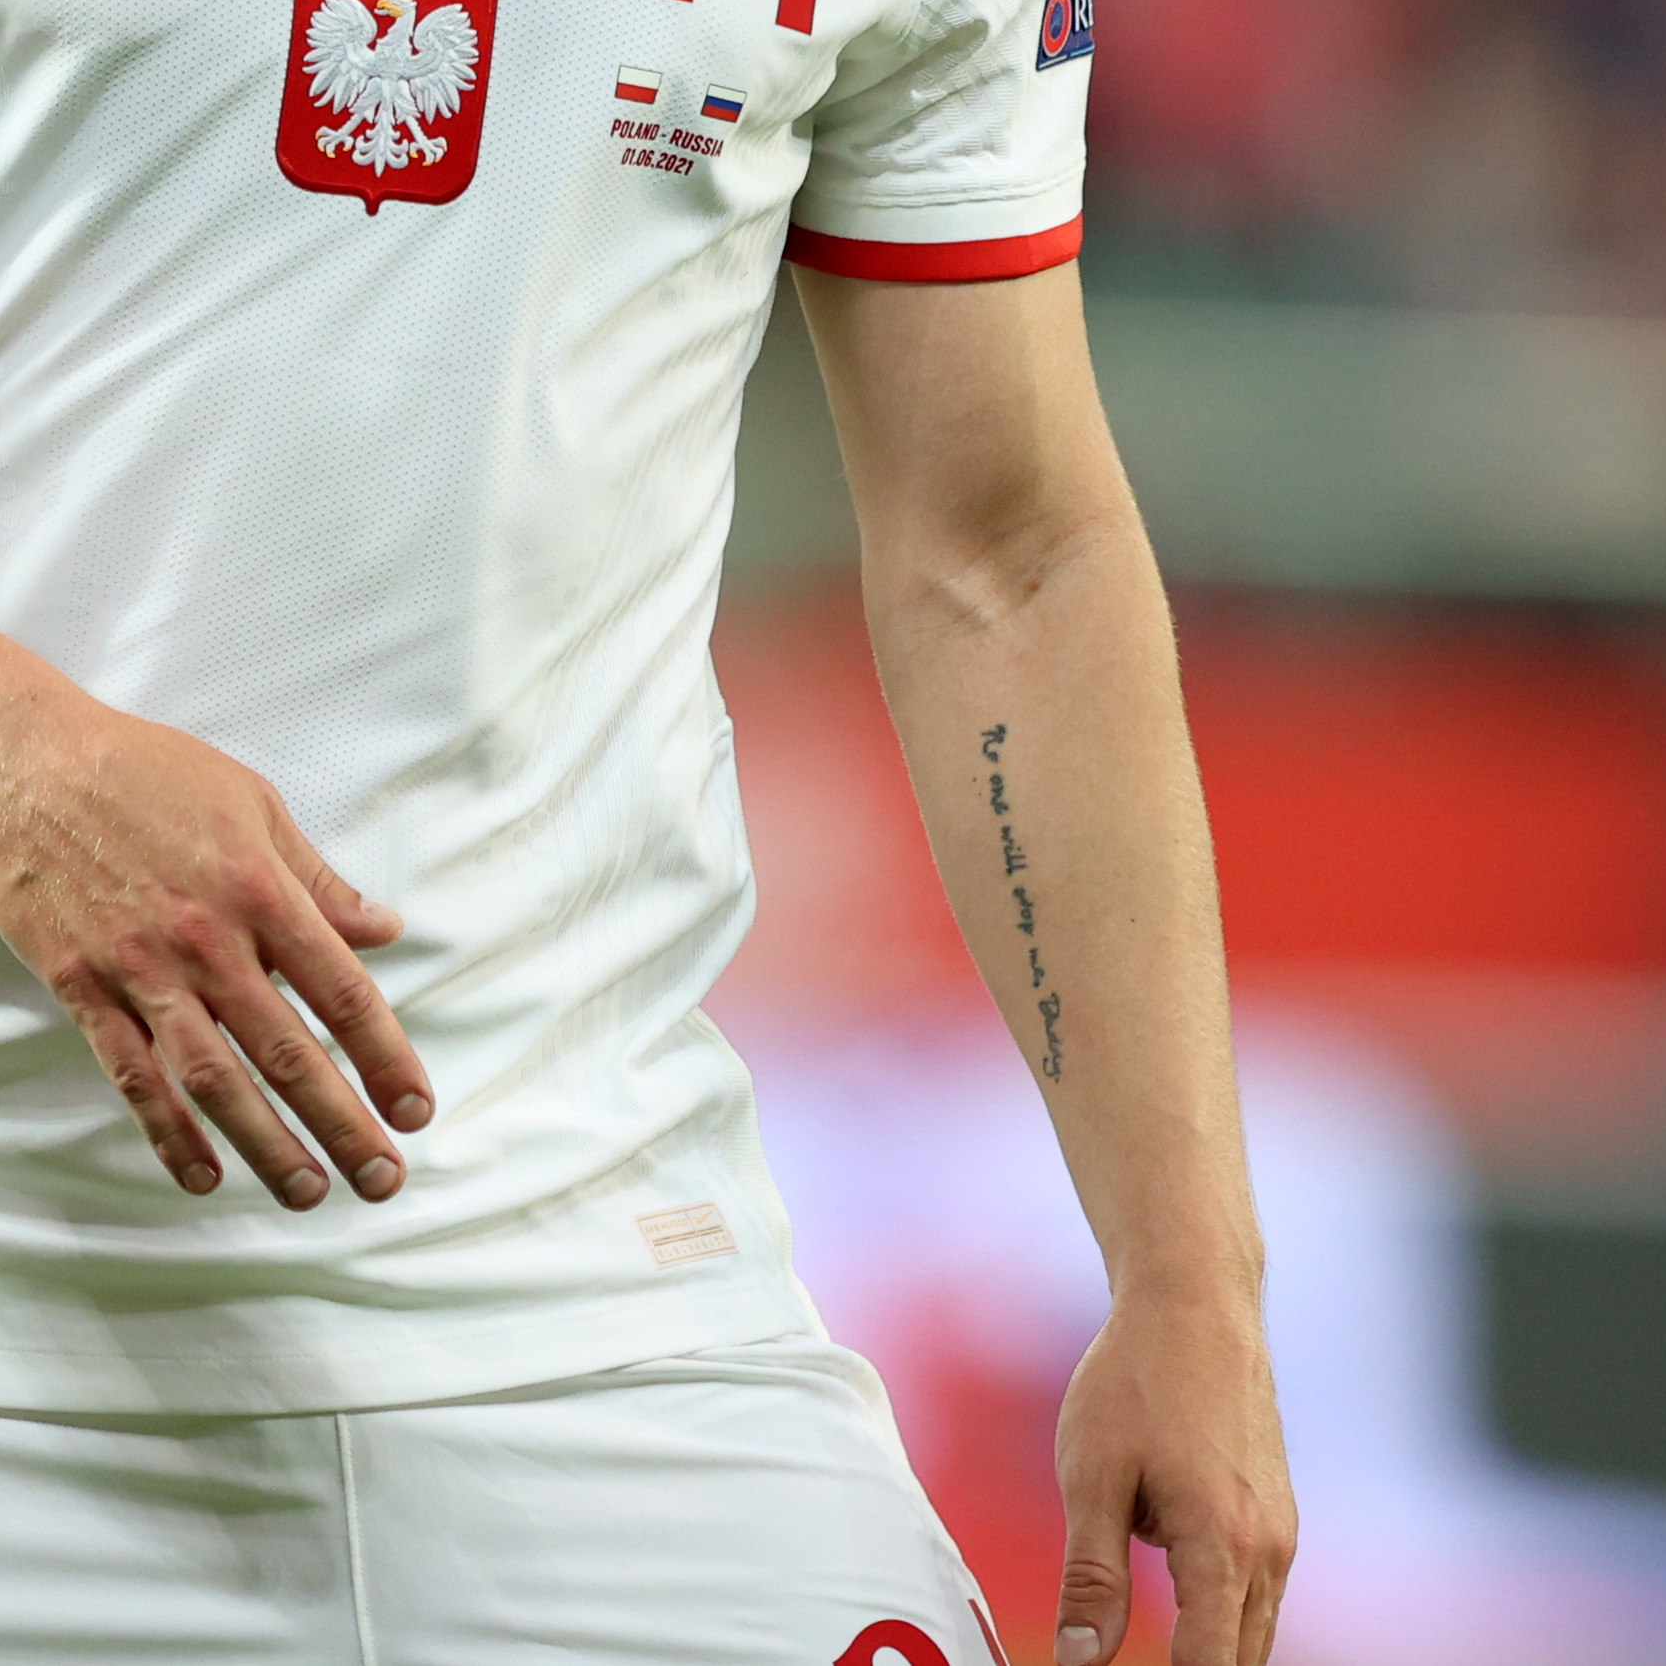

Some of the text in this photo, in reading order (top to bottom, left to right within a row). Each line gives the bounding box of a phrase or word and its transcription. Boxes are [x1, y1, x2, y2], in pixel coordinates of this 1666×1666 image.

[610, 119, 660, 141] POLAND
[669, 129, 724, 157] RUSSIA
[621, 148, 694, 175] 01.06.2021
[1001, 825, 1028, 876] will
